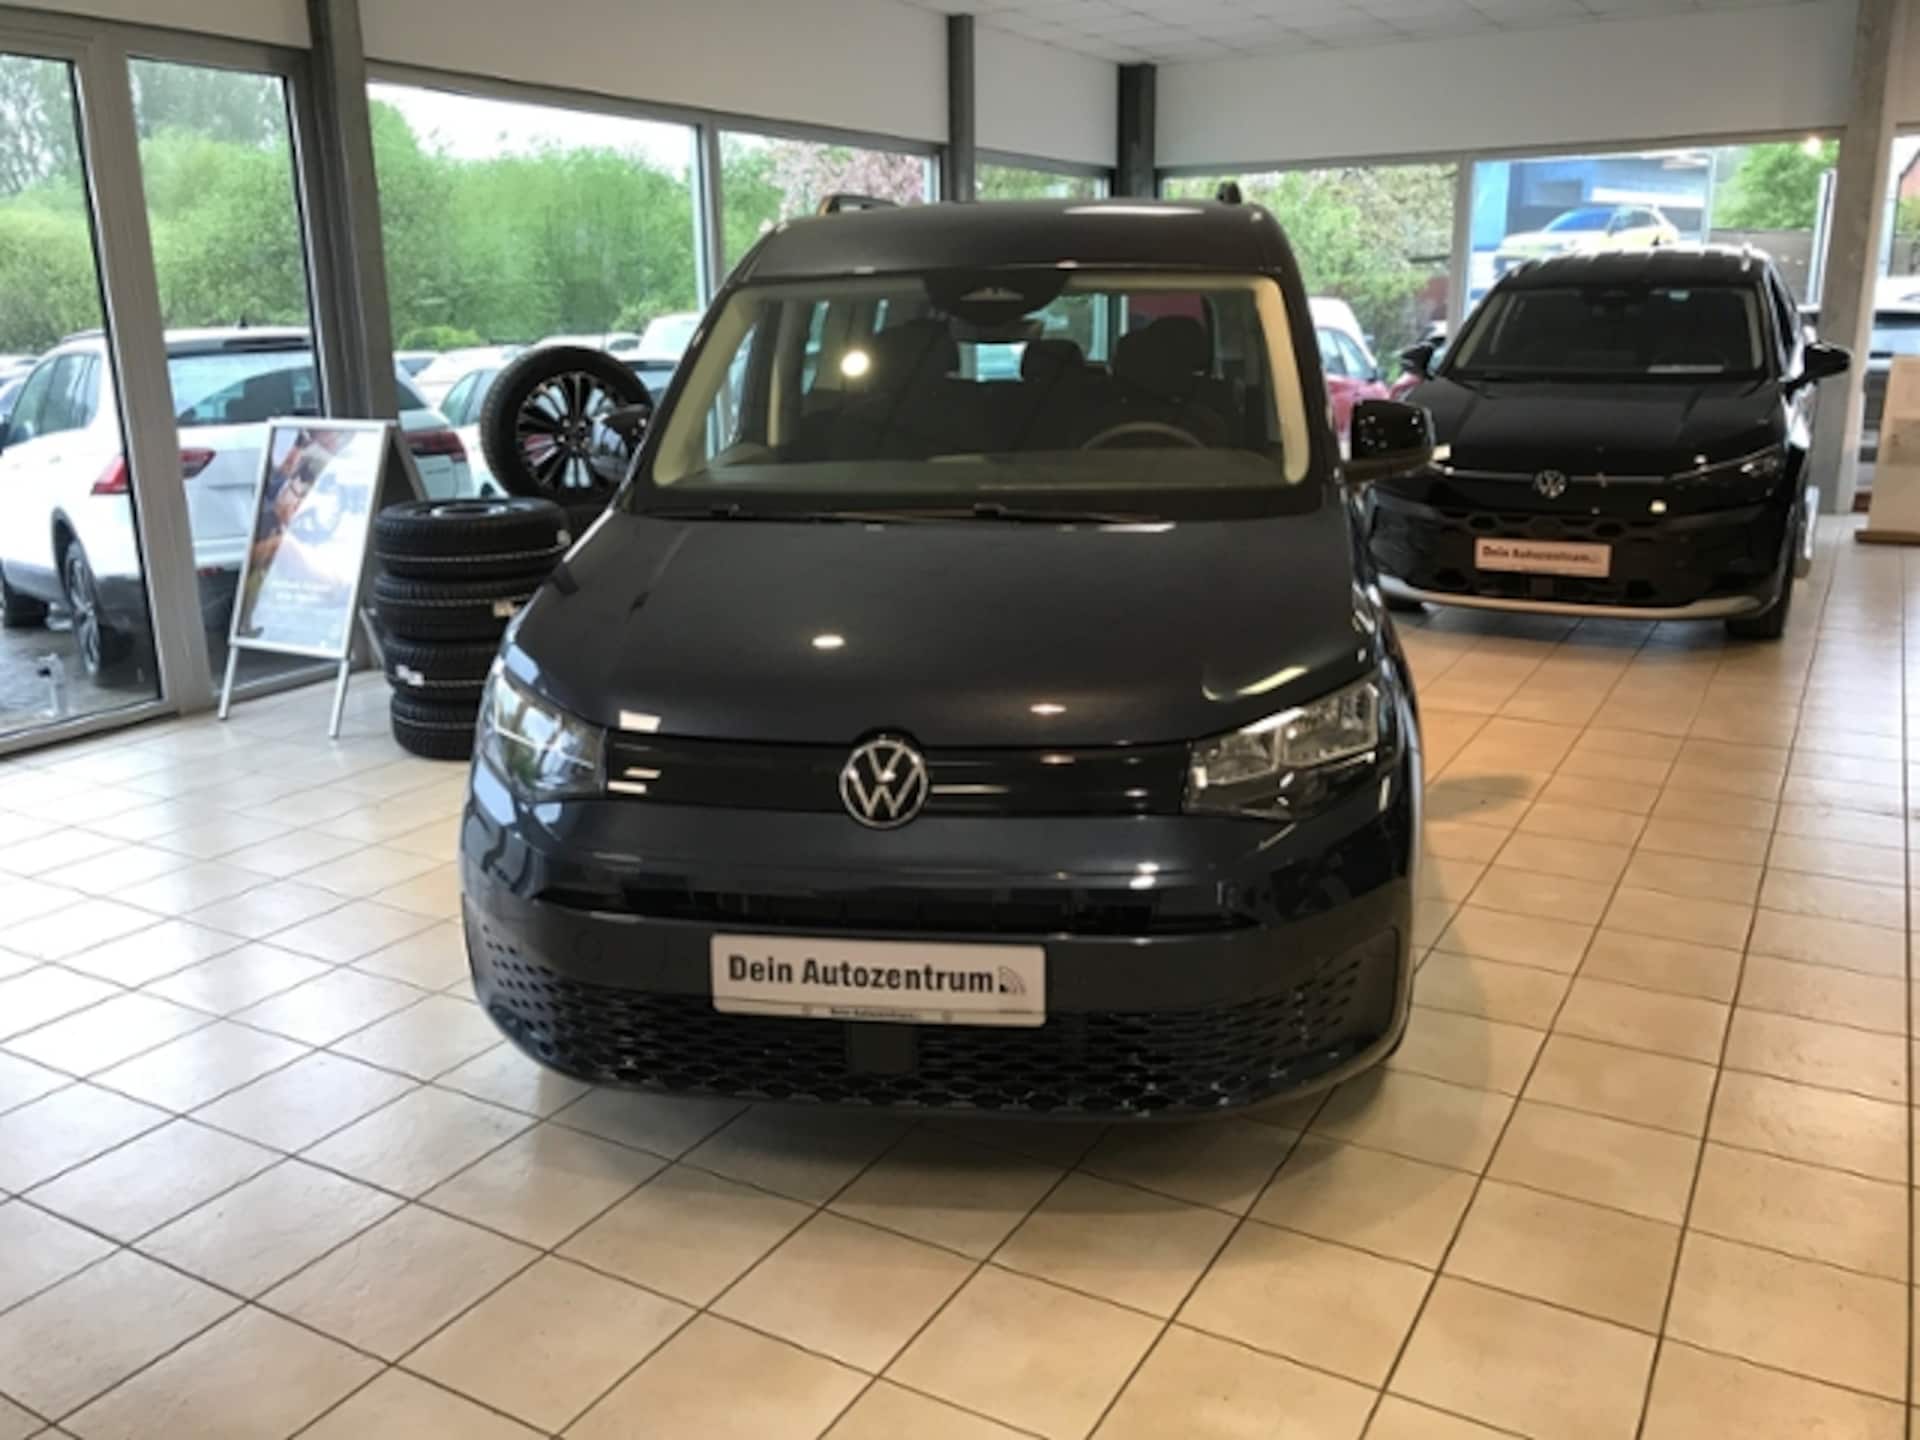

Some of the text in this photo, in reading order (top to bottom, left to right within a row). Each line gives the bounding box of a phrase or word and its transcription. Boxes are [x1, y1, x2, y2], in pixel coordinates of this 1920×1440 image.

[840, 739, 928, 828] VW
[728, 953, 994, 994] Dein Autozentrum
